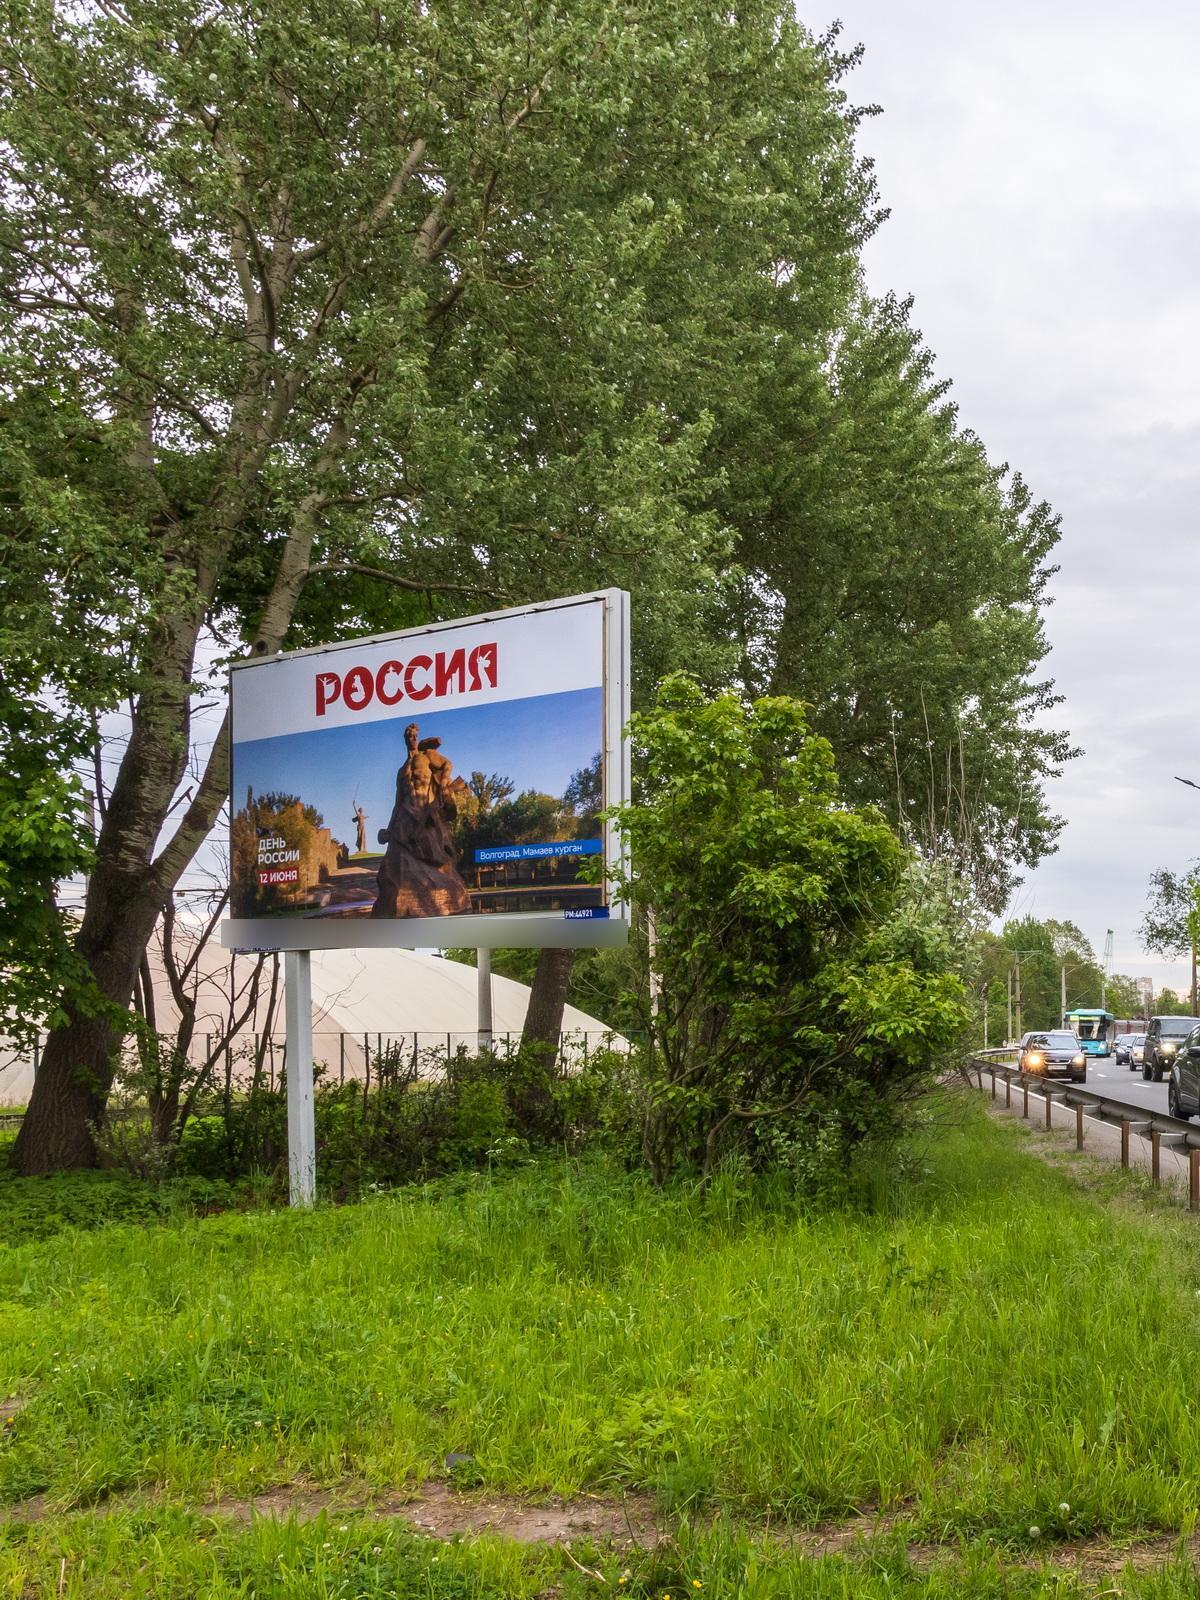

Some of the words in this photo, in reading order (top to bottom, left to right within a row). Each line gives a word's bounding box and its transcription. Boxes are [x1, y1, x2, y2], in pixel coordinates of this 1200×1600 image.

[316, 642, 498, 716] РОССИЯ
[259, 837, 286, 852] ДЕНЬ
[480, 850, 521, 860] Волгоград.
[523, 847, 553, 857] Мамаев
[555, 844, 583, 856] курган
[257, 850, 300, 865] РОССИИ
[260, 873, 268, 884] 12
[270, 870, 298, 883] ИЮНЯ
